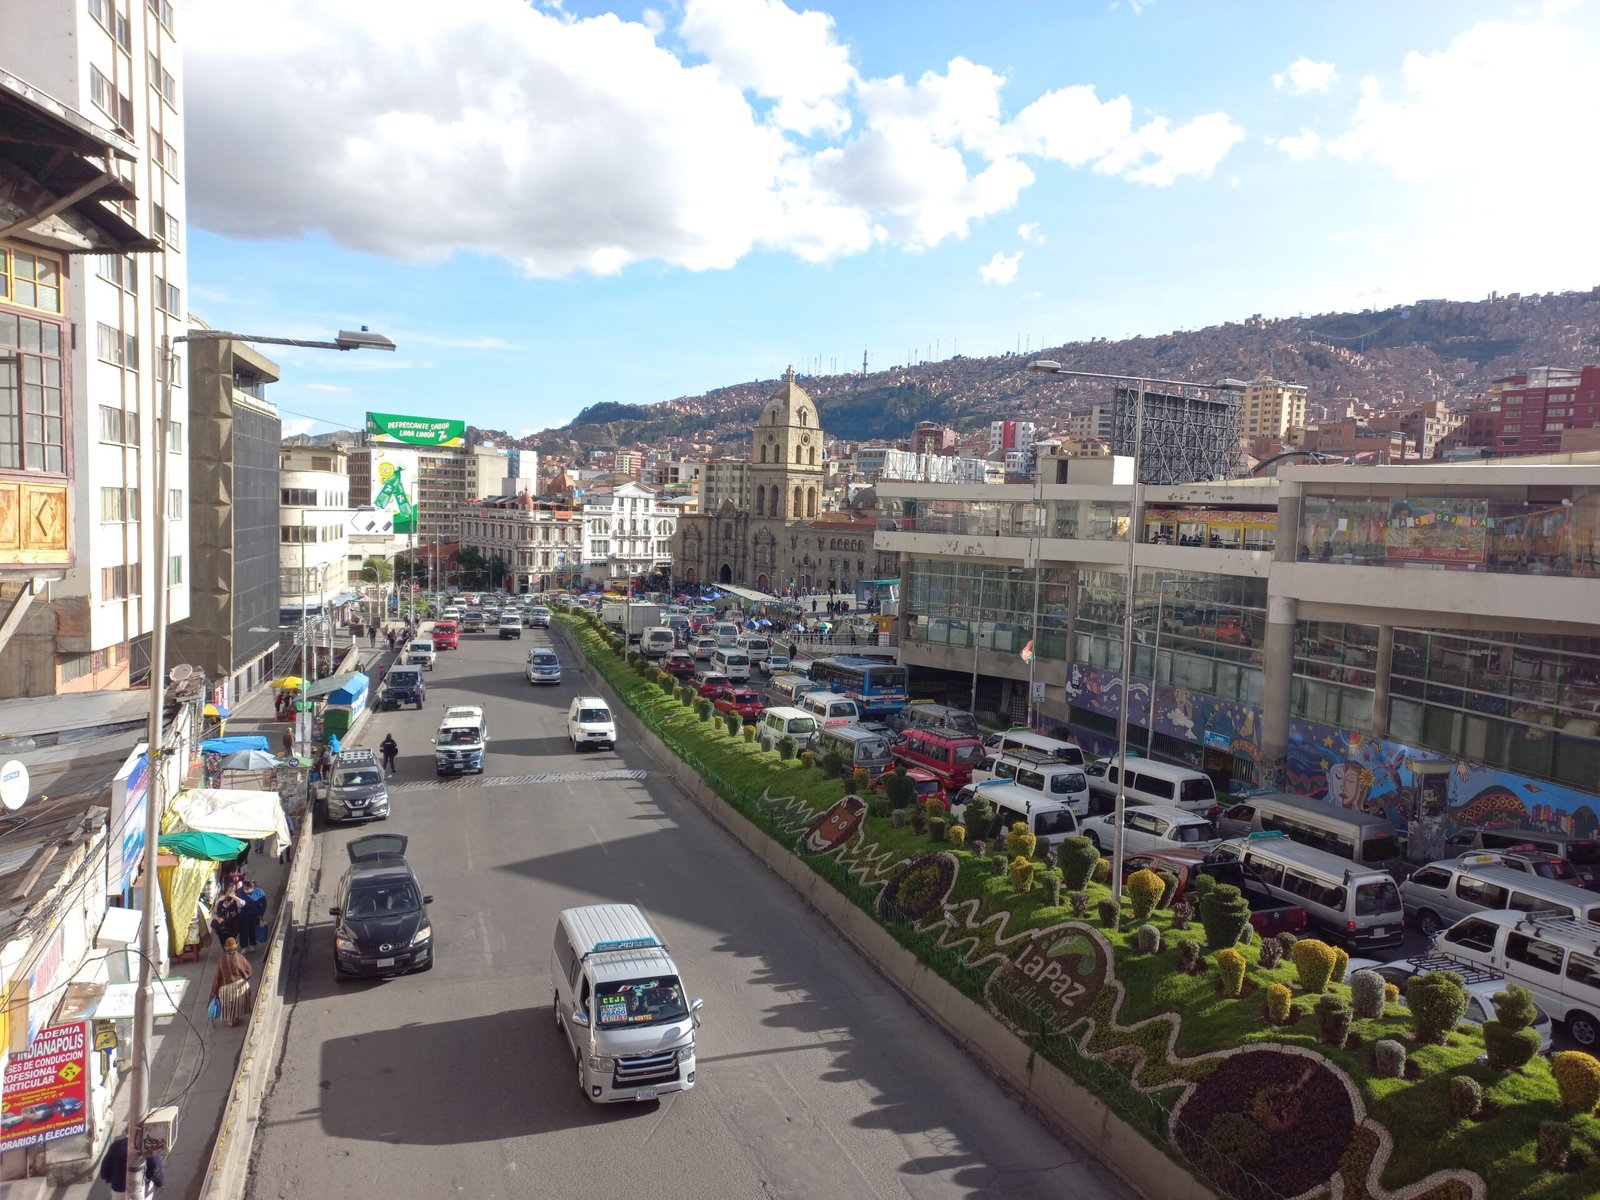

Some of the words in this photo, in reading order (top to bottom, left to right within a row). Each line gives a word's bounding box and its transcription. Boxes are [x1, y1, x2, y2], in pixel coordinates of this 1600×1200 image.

[388, 421, 429, 430] REFRESCANTE
[431, 422, 450, 430] SABOR
[36, 1025, 80, 1041] ADEMIA
[4, 1066, 58, 1084] ROFESIONAL
[8, 1063, 22, 1074] SES
[24, 1061, 34, 1071] DE
[3, 1075, 55, 1093] ARTICULAR
[0, 1136, 37, 1151] ORARIOS
[37, 1134, 44, 1143] A
[45, 1124, 84, 1141] ELECCION
